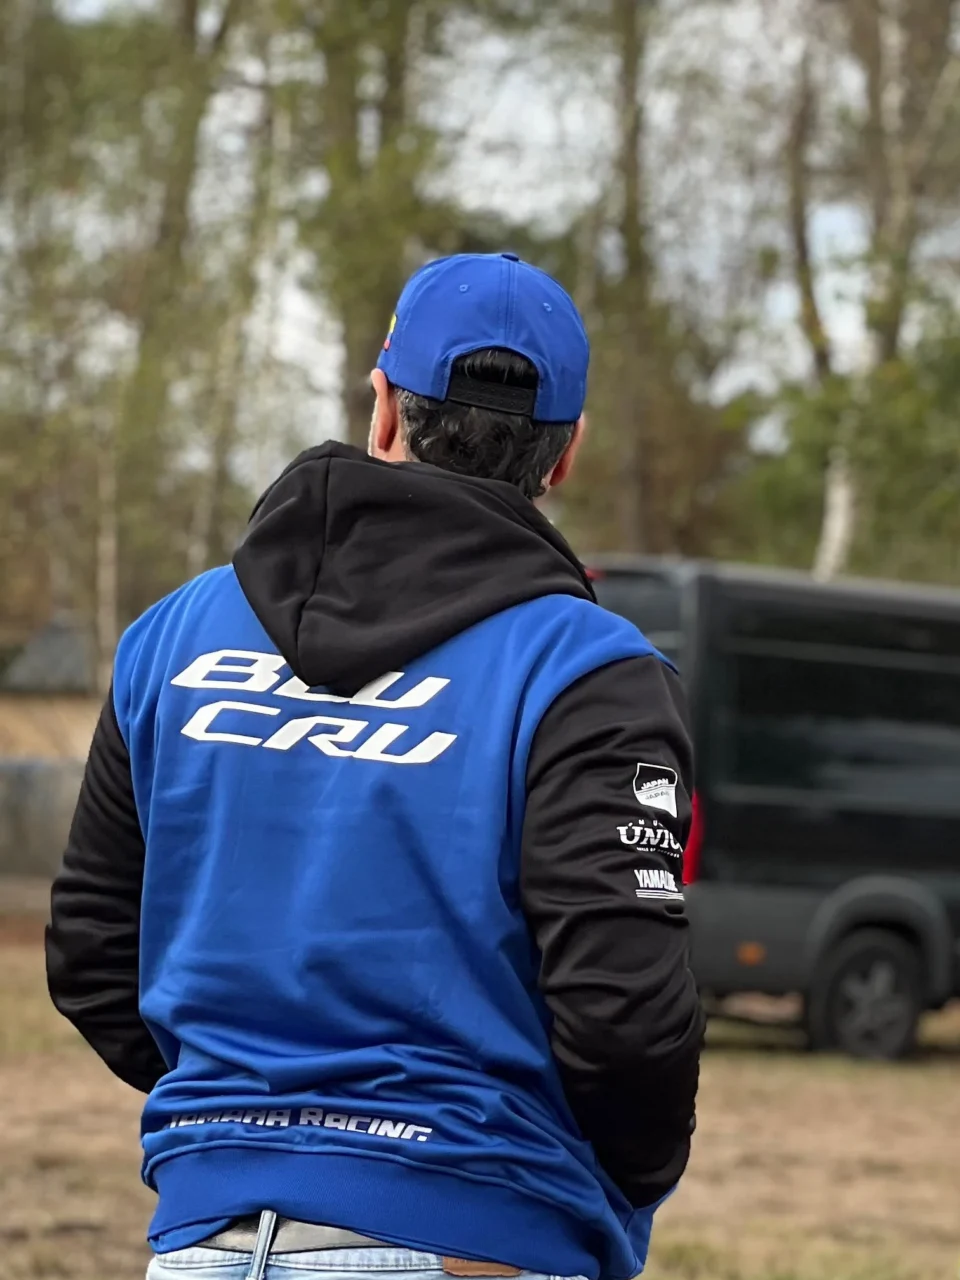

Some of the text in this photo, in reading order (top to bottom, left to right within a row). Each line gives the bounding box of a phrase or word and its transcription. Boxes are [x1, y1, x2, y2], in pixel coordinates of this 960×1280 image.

[170, 649, 451, 708] BLU
[180, 700, 458, 764] CRU
[641, 778, 669, 790] JAPAN
